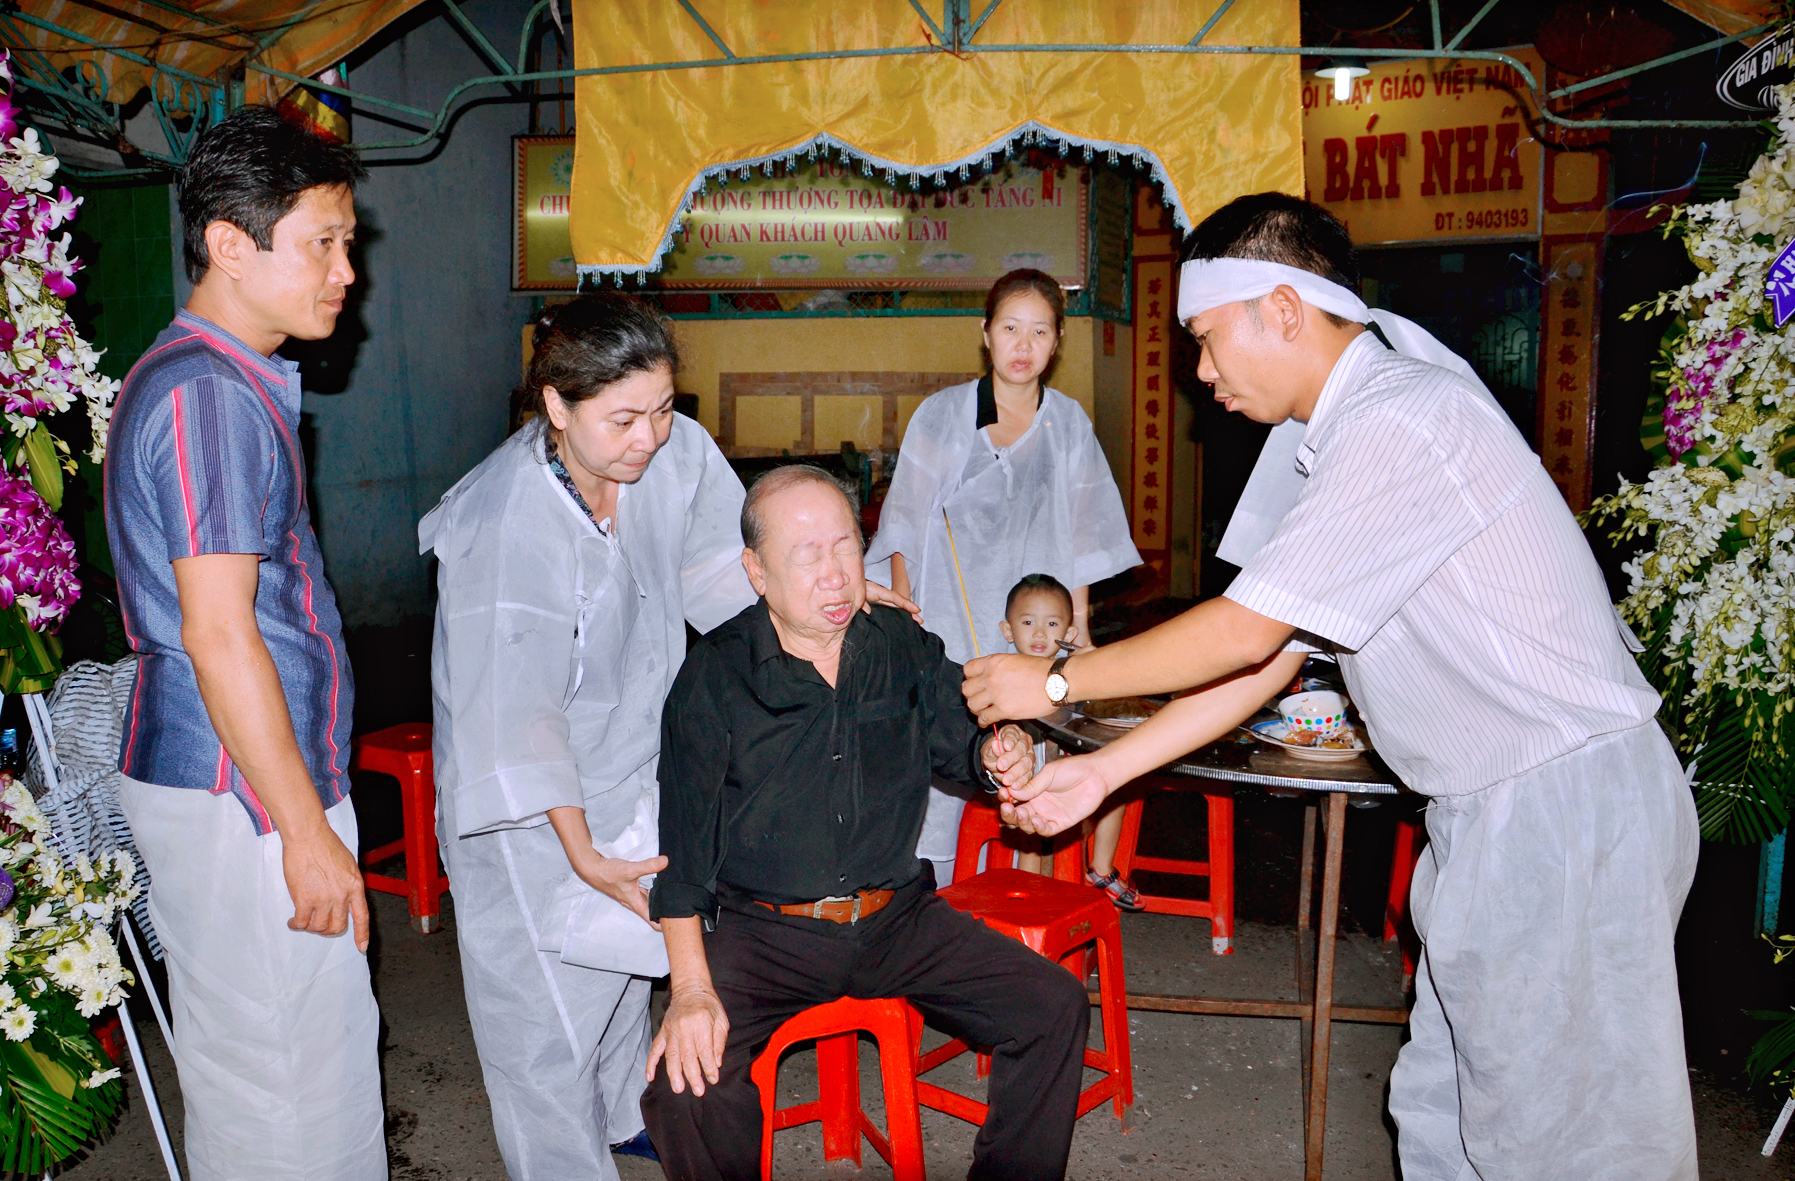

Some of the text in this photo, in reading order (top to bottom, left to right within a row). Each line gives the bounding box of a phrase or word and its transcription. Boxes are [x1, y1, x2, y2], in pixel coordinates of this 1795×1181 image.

[1735, 56, 1757, 88] GIA
[1302, 81, 1319, 116] ỘI
[1326, 77, 1374, 112] PẬT
[1380, 68, 1425, 102] GIÁO
[1433, 64, 1478, 100] VIỆT
[1324, 113, 1406, 202] BÁT
[1421, 105, 1523, 197] NHÃ
[758, 186, 839, 214] THƯỢNG
[845, 189, 886, 213] TỌA
[982, 182, 1035, 208] TĂNG
[700, 222, 752, 249] QUAN
[758, 216, 827, 243] KHÁCH
[834, 221, 901, 248] QUANG
[907, 215, 948, 241] LÂM
[1466, 208, 1528, 231] 9403193
